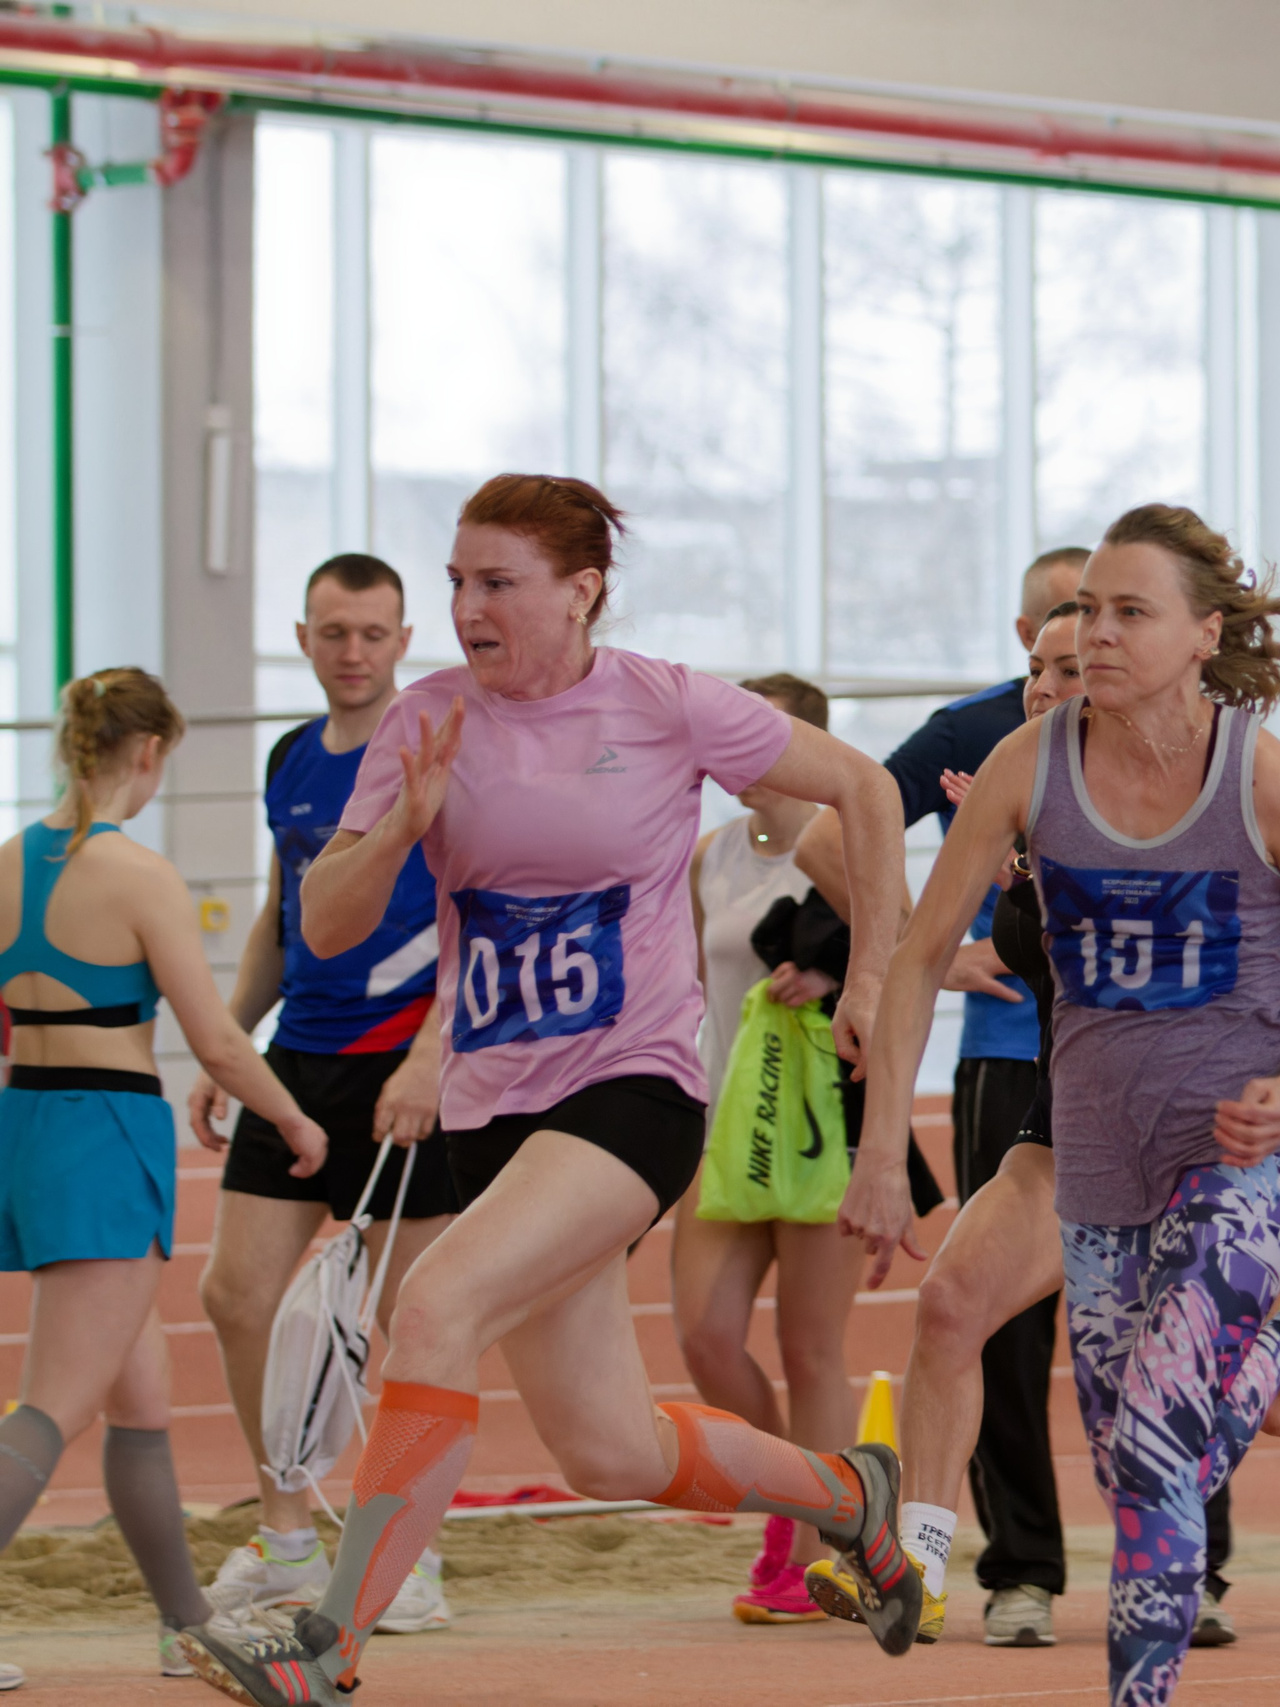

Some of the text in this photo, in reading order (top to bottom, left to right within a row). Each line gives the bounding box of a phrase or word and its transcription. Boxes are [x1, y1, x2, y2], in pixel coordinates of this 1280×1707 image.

[464, 923, 599, 1029] 015
[1071, 917, 1205, 989] 151
[747, 1032, 783, 1189] NIKE RACING
